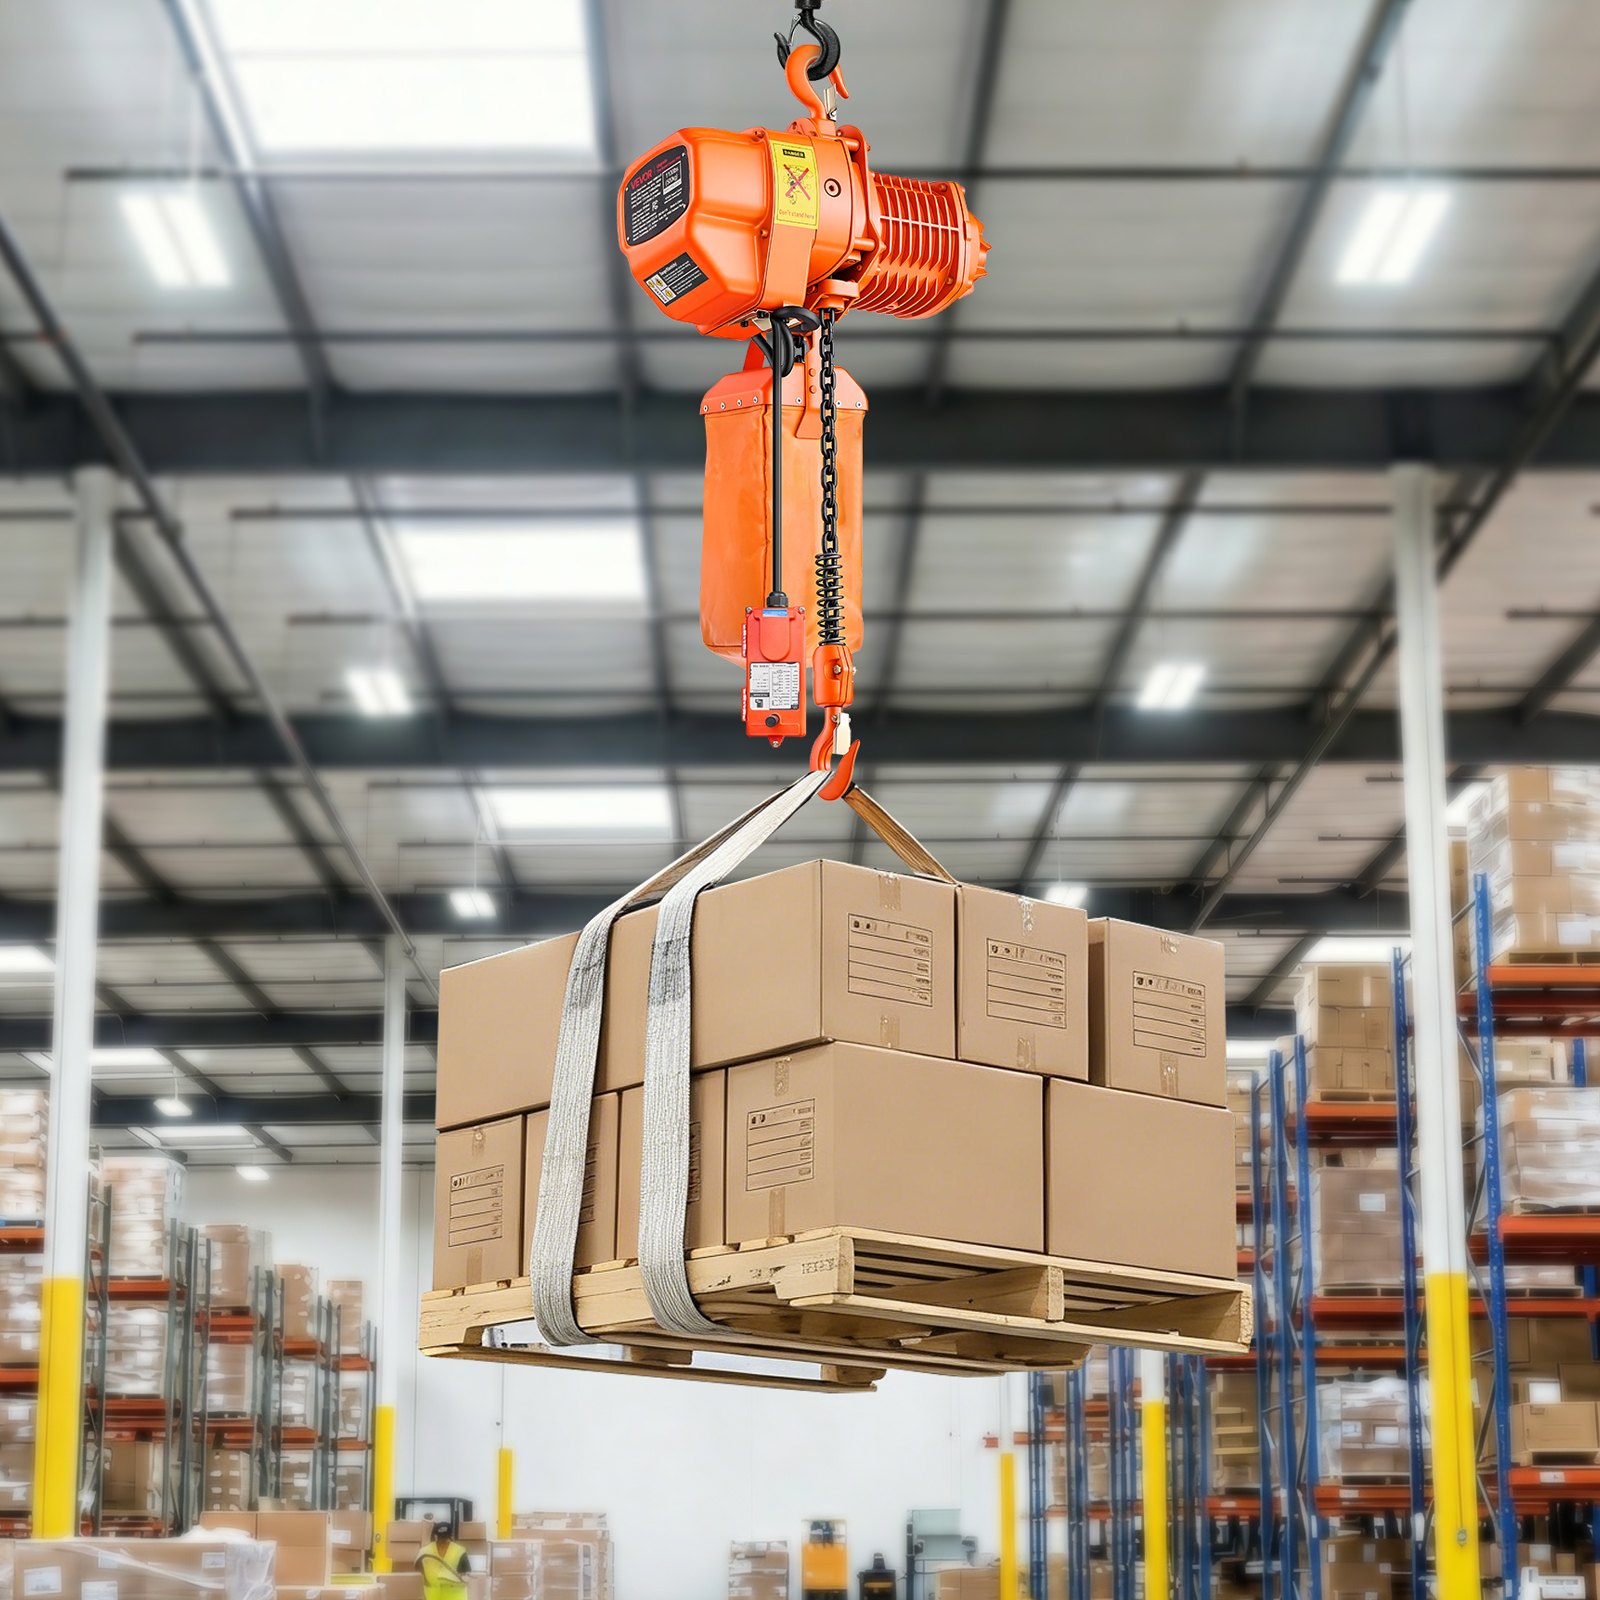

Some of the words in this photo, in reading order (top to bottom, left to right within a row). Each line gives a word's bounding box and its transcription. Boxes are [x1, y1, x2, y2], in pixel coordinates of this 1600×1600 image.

[784, 149, 804, 158] DANGER
[630, 169, 653, 190] VEVOR
[779, 208, 791, 217] Don't
